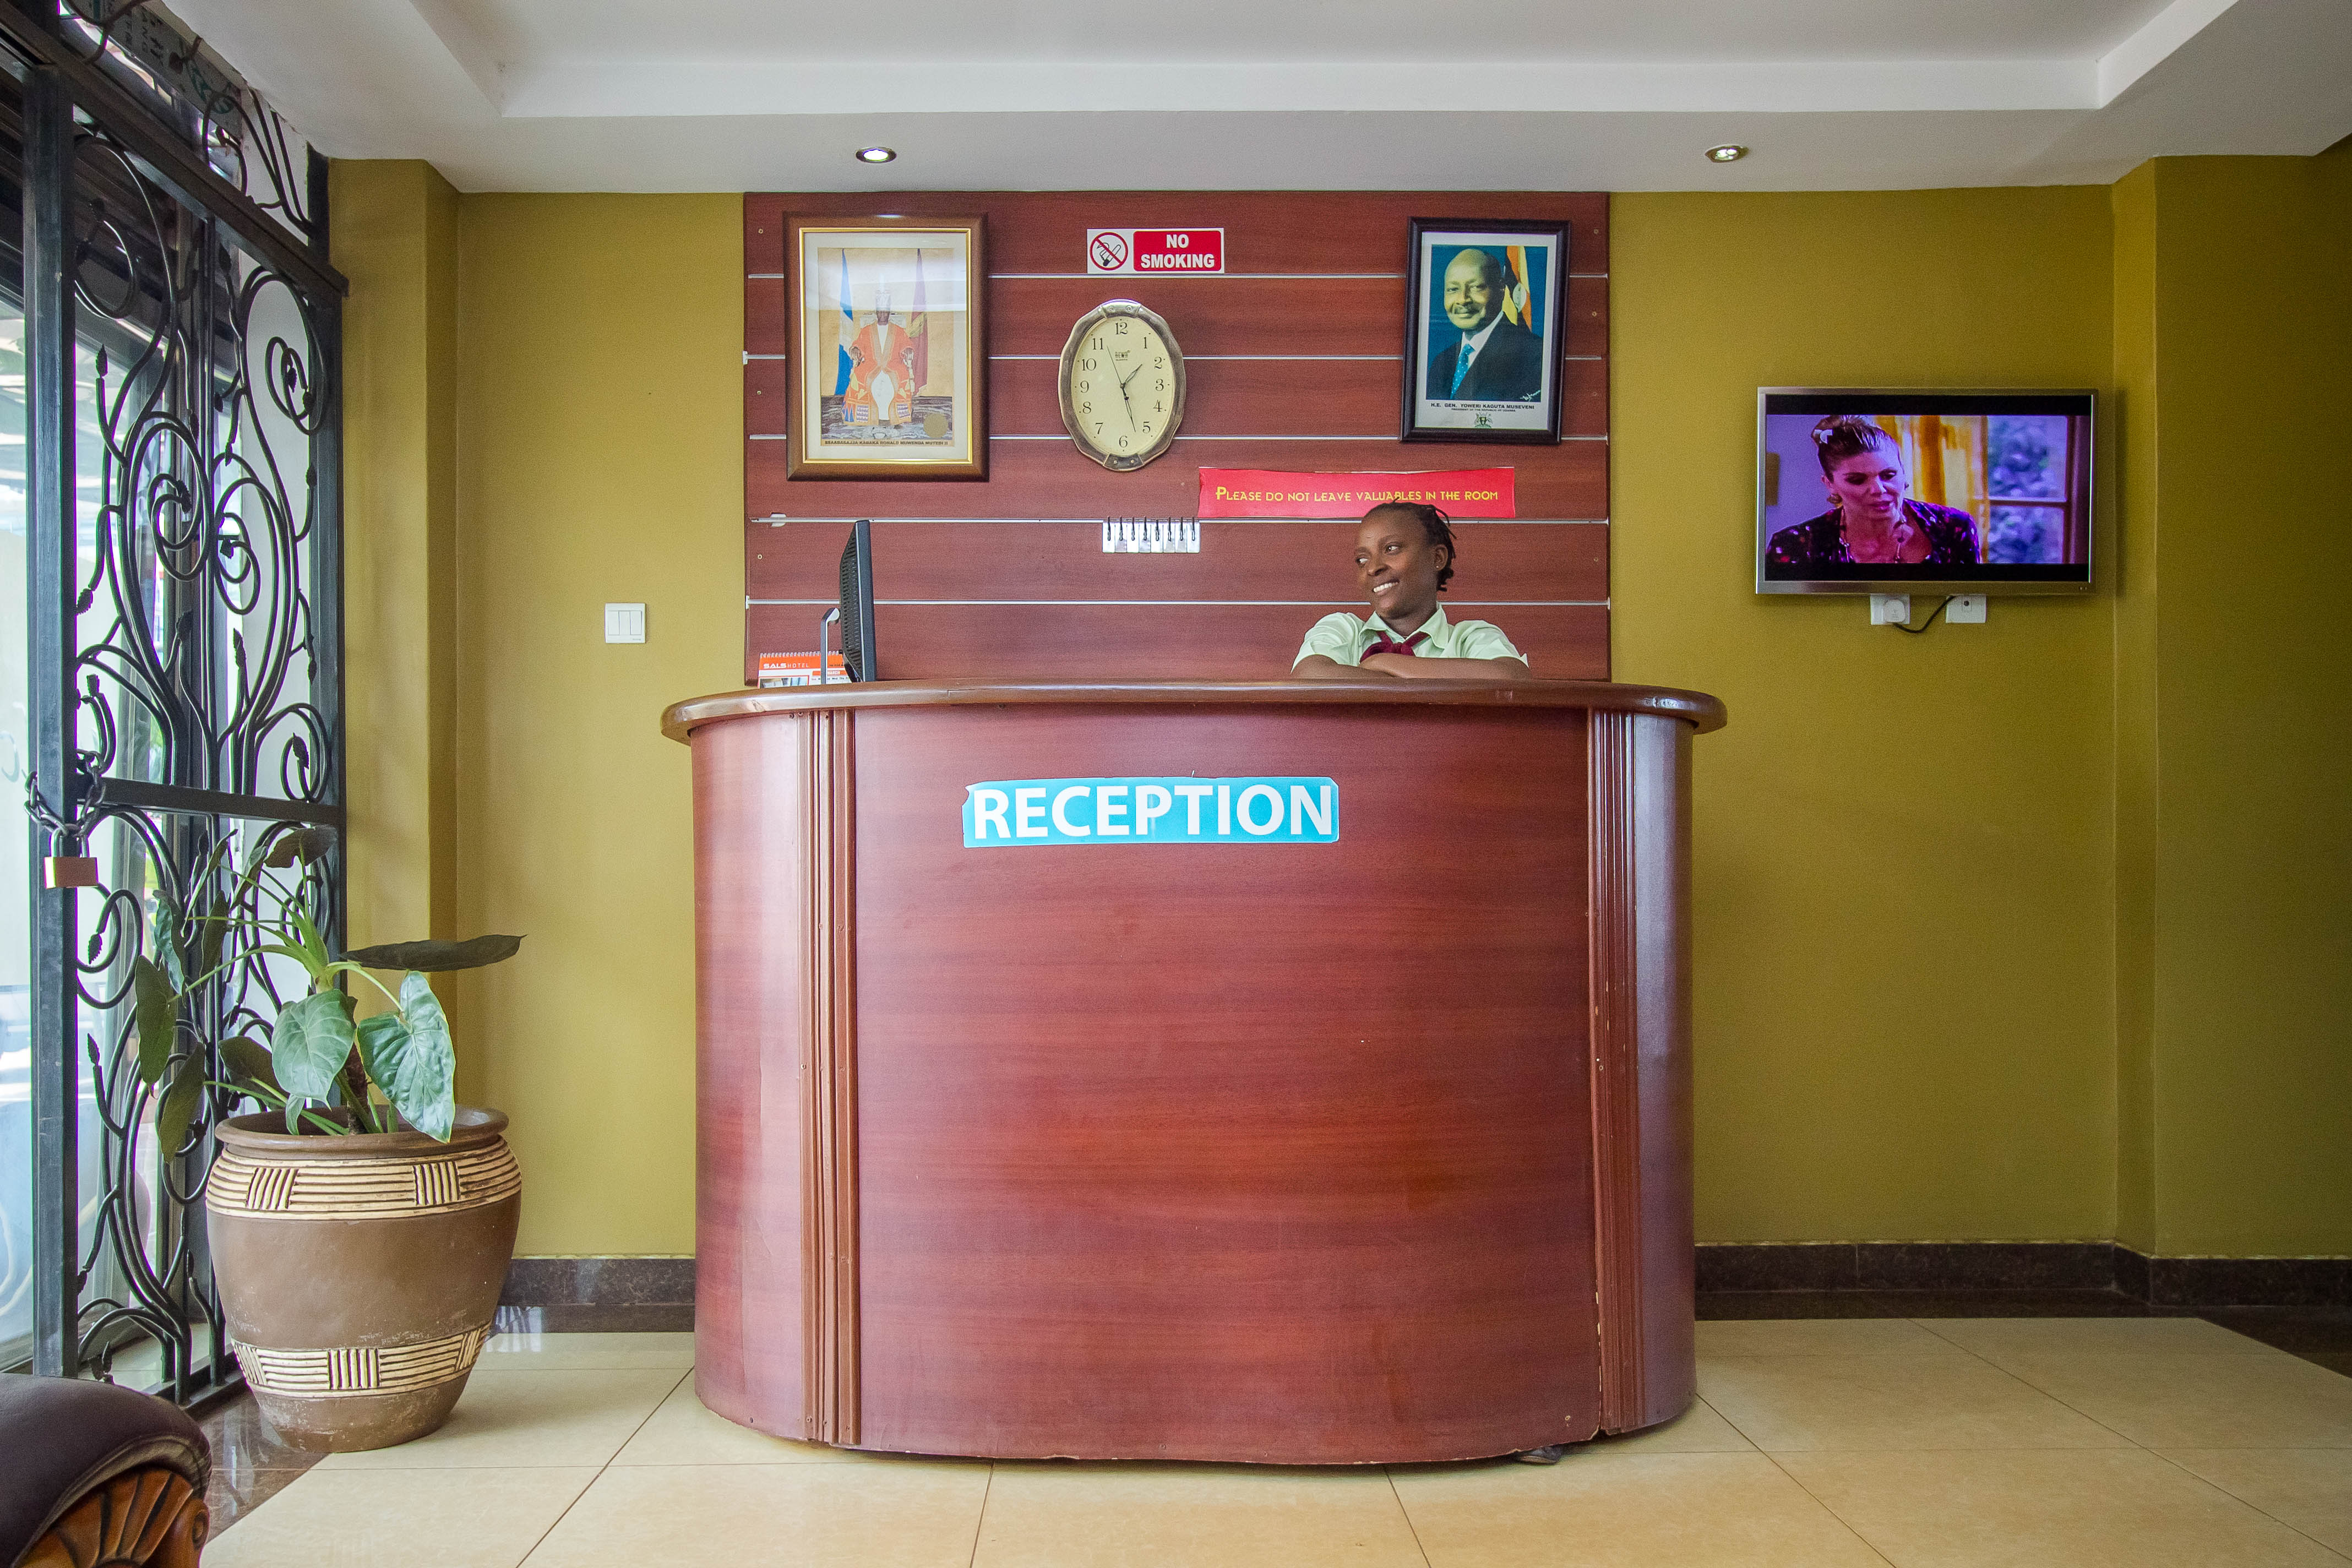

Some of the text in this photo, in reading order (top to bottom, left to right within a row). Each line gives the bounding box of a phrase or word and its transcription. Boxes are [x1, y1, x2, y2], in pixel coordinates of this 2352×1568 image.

[1166, 234, 1189, 248] NO
[1141, 254, 1215, 268] SMOKING
[1115, 322, 1128, 335] 12
[1092, 337, 1104, 350] 11
[1143, 337, 1148, 349] 1
[1082, 358, 1097, 371] 10
[1154, 357, 1162, 369] 2
[1080, 380, 1090, 393] 9
[1155, 379, 1164, 391] 3
[1082, 401, 1092, 414] 8
[1153, 400, 1163, 412] 4
[1095, 422, 1104, 434] 7
[1142, 421, 1151, 433] 5
[1119, 435, 1128, 448] 6
[1215, 486, 1498, 502] PLEASE DO NOT LEAVE VALUABLES IN THE ROOM
[973, 785, 1332, 839] RECEPTION
